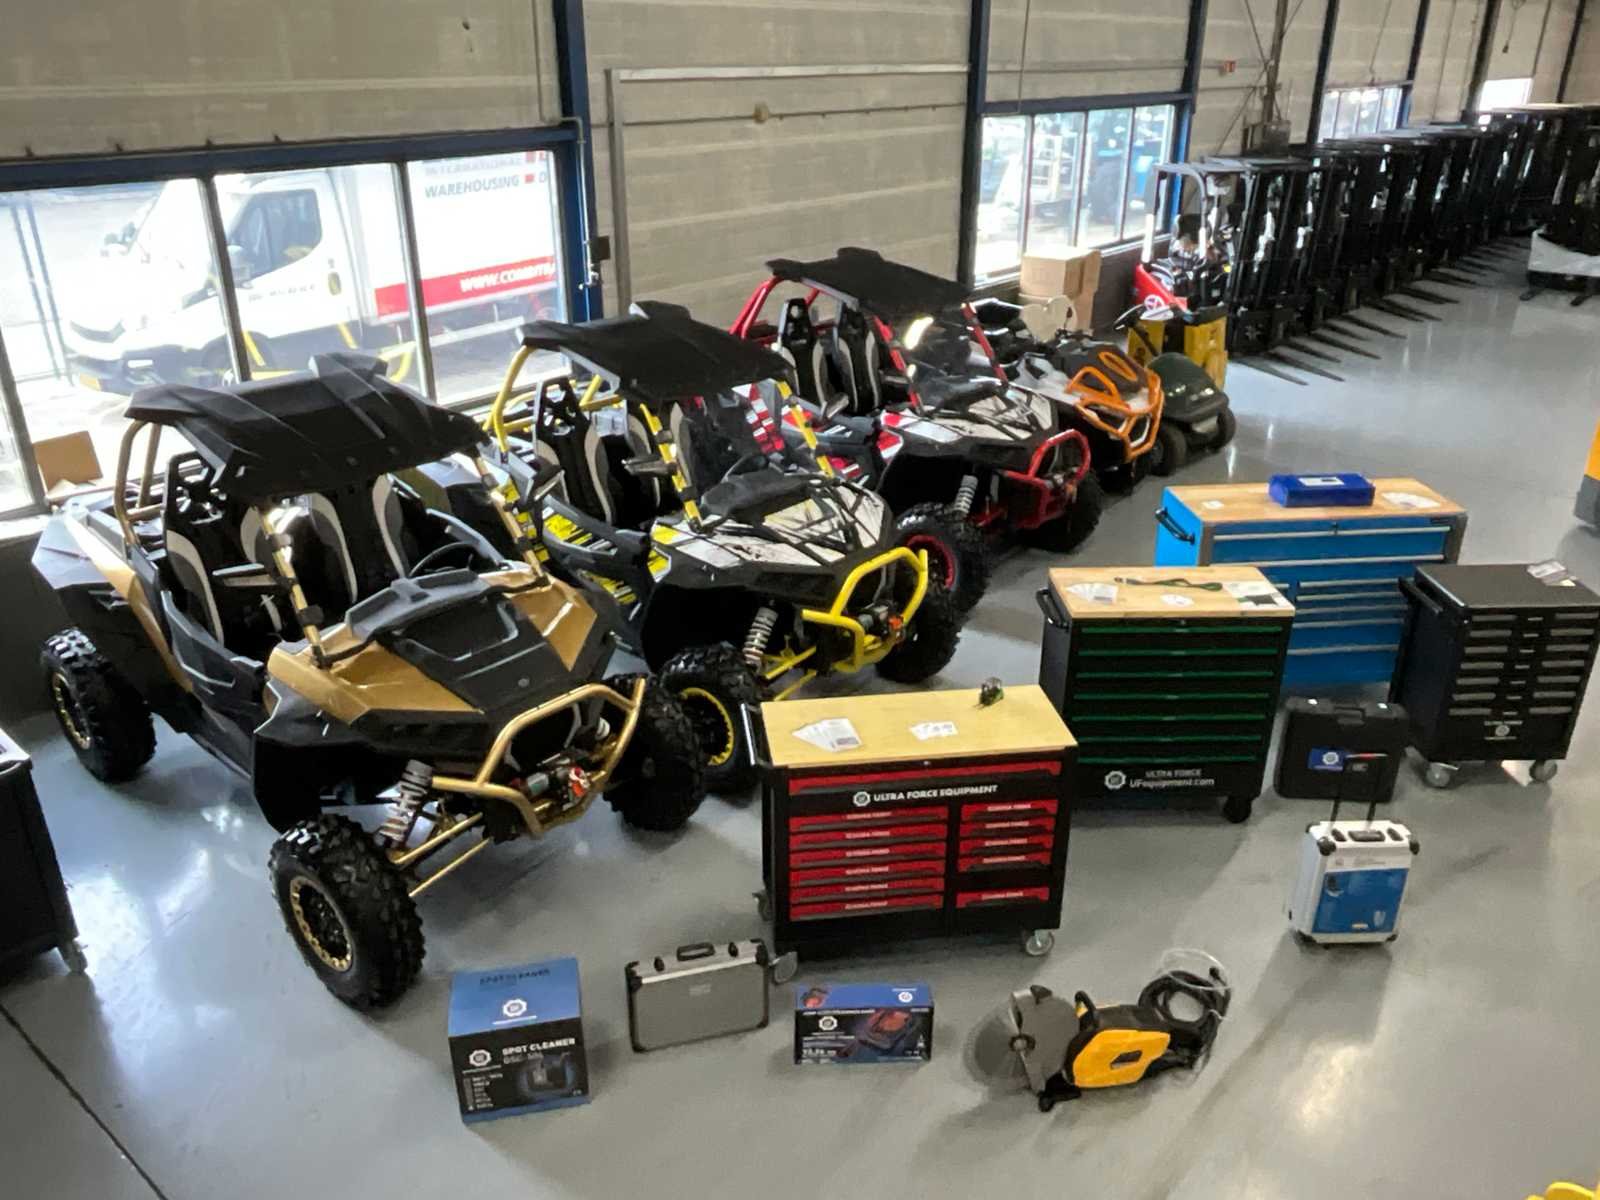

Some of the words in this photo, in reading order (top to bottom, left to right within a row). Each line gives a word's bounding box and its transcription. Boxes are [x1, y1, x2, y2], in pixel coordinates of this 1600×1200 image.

[425, 174, 520, 198] WAREHOUSING
[1145, 769, 1172, 778] ULTRA
[1174, 768, 1201, 777] FORCE
[873, 791, 905, 801] ULTRA
[906, 788, 937, 800] FORCE
[939, 785, 998, 797] EQUIPMENT
[502, 1044, 528, 1056] SPOT
[529, 1037, 575, 1052] CLEANER
